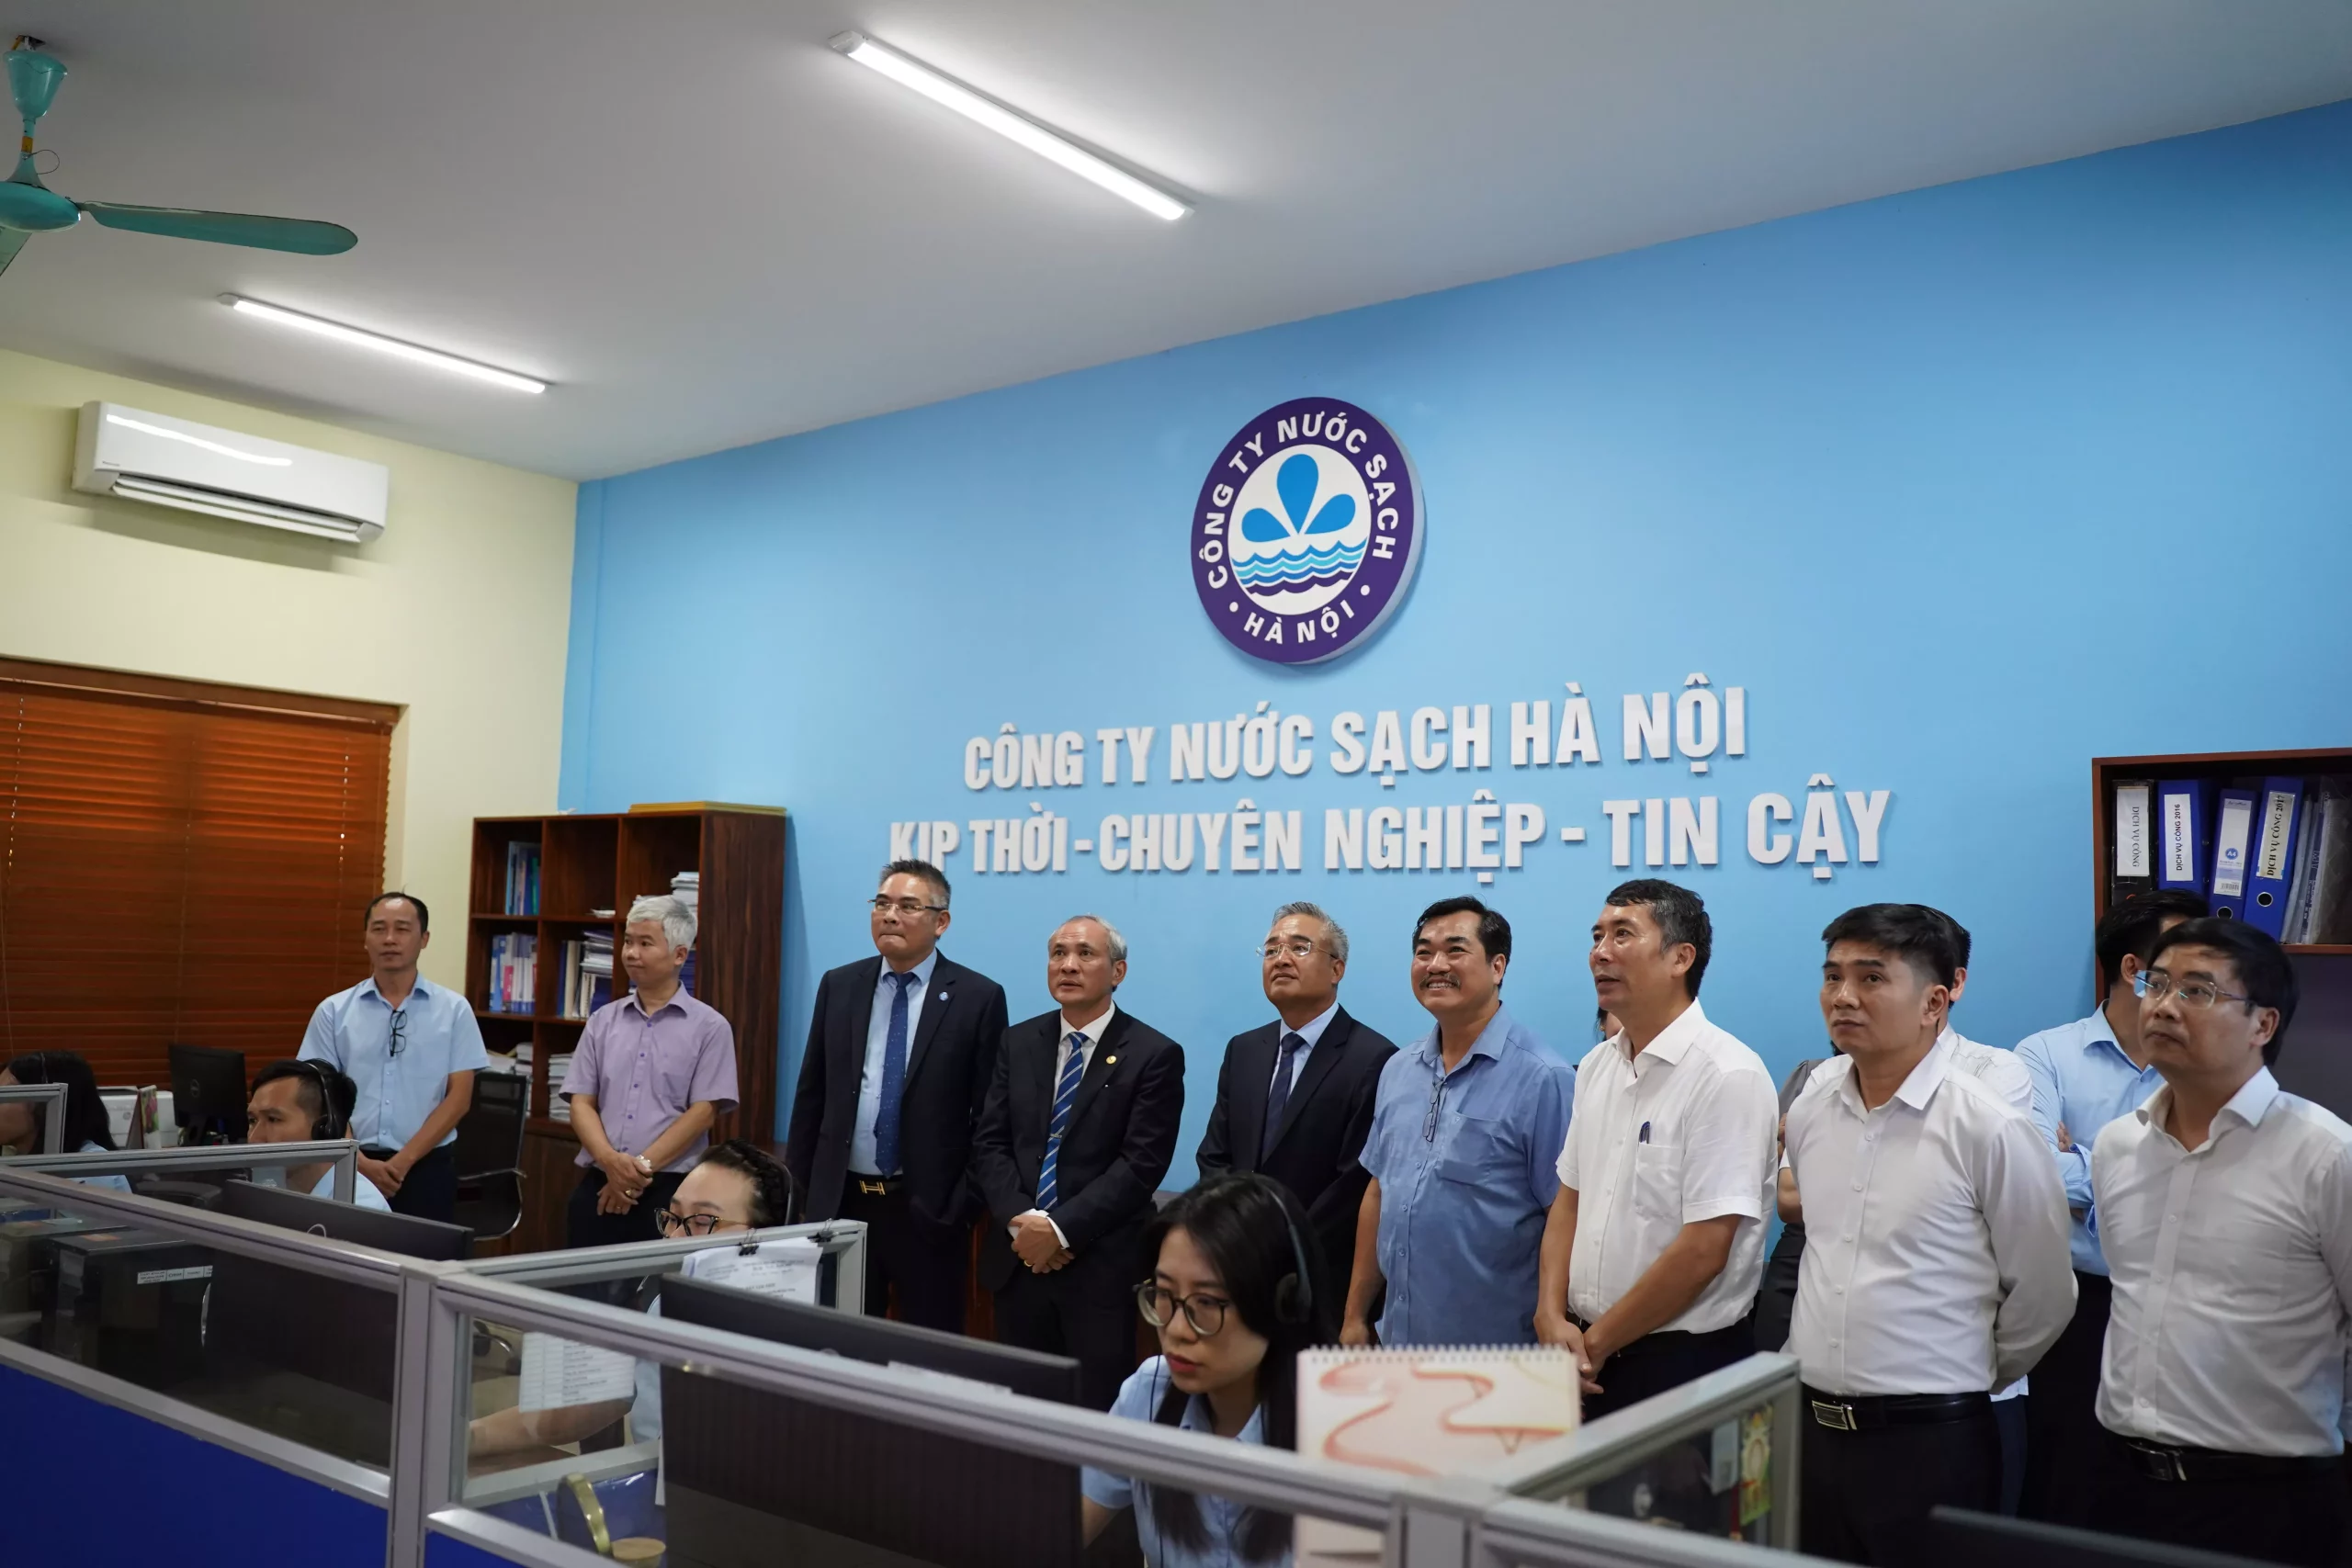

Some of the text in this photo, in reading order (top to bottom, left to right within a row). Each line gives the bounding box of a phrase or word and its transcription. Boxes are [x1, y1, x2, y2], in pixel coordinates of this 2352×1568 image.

[1198, 411, 1399, 590] CÔNG TY NƯỚC SẠCH
[1243, 599, 1355, 645] HÀ NỘI
[964, 672, 1746, 790] CÔNG TY NƯỚC SẠCH HÀ NỘI
[968, 801, 1069, 873] THỜI
[1099, 797, 1303, 872] CHUYÊN
[1324, 788, 1546, 884] NGHIỆP
[1602, 795, 1719, 867] TIN
[1747, 773, 1892, 879] CẬY
[2132, 807, 2143, 868] DỊCH VỤ CÔNG
[2174, 804, 2184, 871] DỊCH VỤ CÔNG 2016
[2267, 795, 2286, 876] DỊCH VỤ CÔNG 2017
